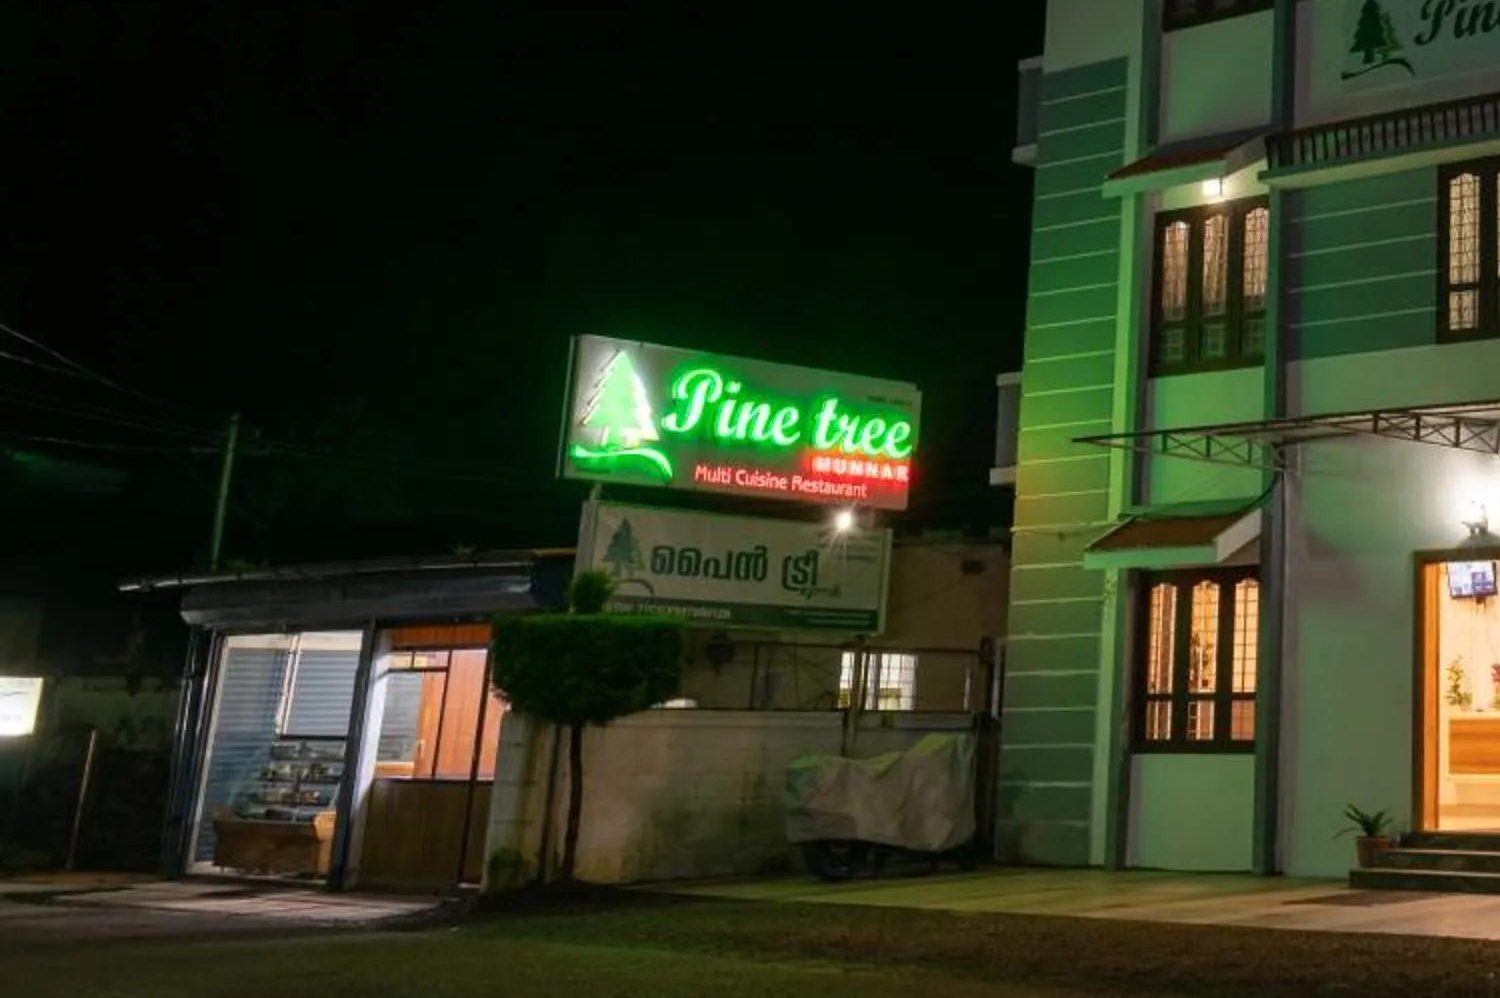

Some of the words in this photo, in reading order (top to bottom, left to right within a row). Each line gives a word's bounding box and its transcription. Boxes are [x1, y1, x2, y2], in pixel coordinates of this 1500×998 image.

[661, 368, 801, 447] Pine
[811, 398, 913, 459] tree
[694, 464, 732, 485] Multi
[735, 468, 788, 492] Cuisine
[791, 475, 868, 499] Restaurant
[811, 456, 910, 482] MUNNAR
